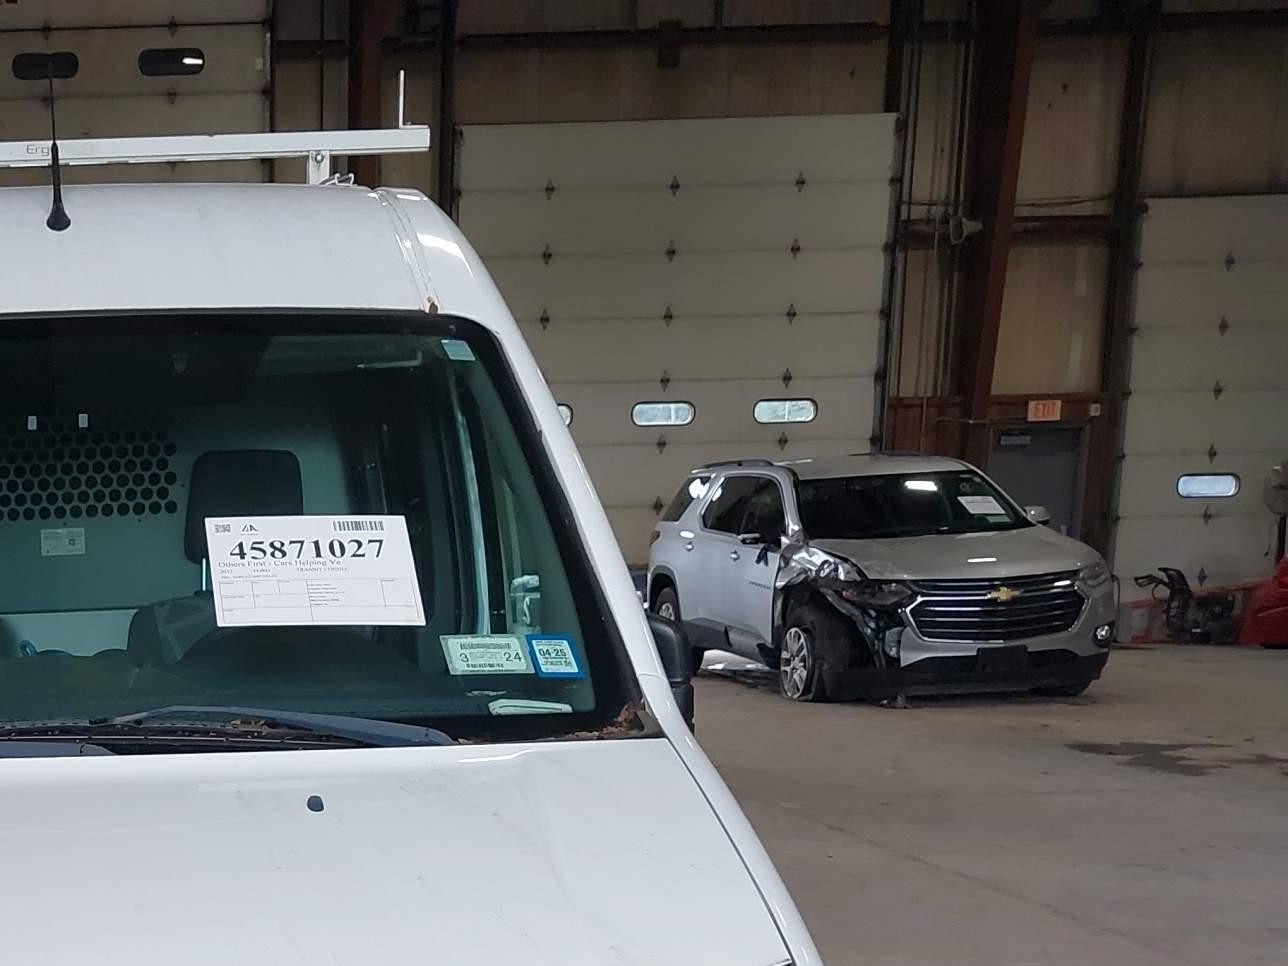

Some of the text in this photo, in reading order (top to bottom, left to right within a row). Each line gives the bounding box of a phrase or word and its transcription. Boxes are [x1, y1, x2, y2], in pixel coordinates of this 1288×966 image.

[26, 143, 50, 157] Erg
[229, 539, 385, 560] 45871027
[218, 560, 246, 568] Others
[294, 559, 327, 568] Helping
[459, 651, 523, 664] 3 24
